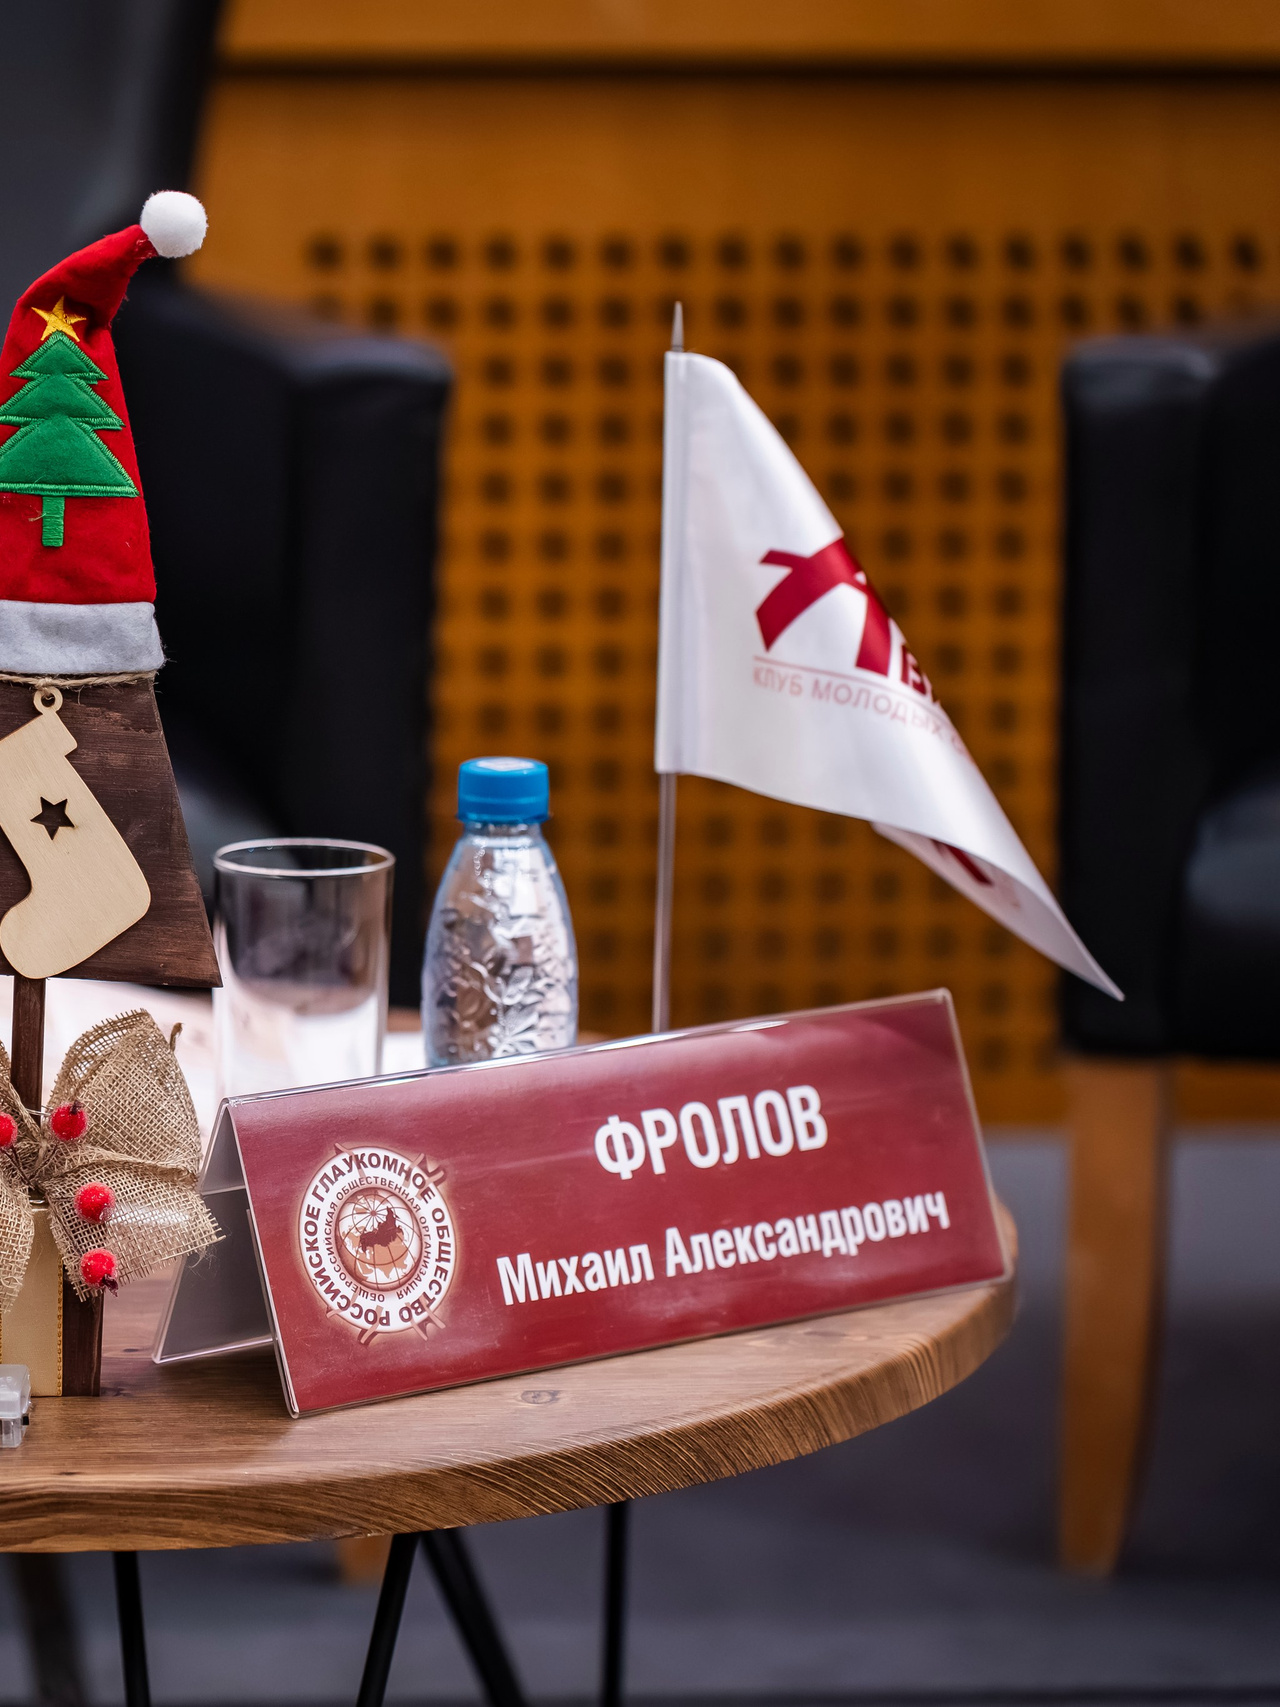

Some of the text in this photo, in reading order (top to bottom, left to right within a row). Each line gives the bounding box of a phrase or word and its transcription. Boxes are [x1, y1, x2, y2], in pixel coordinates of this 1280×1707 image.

[753, 666, 944, 738] КЛУБ МОЛОДЫХ
[594, 1085, 828, 1180] ФРОЛОВ
[304, 1152, 452, 1327] РОССИЙСКОЕ ГЛАУКОМНОЕ ОБЩЕСТВО
[323, 1176, 433, 1303] ОБЩЕРОССИЙСКАЯ ОБЩЕСТВЕННАЯ ОРГАНИЗАЦИЯ
[496, 1192, 950, 1306] Михаил Александрович
